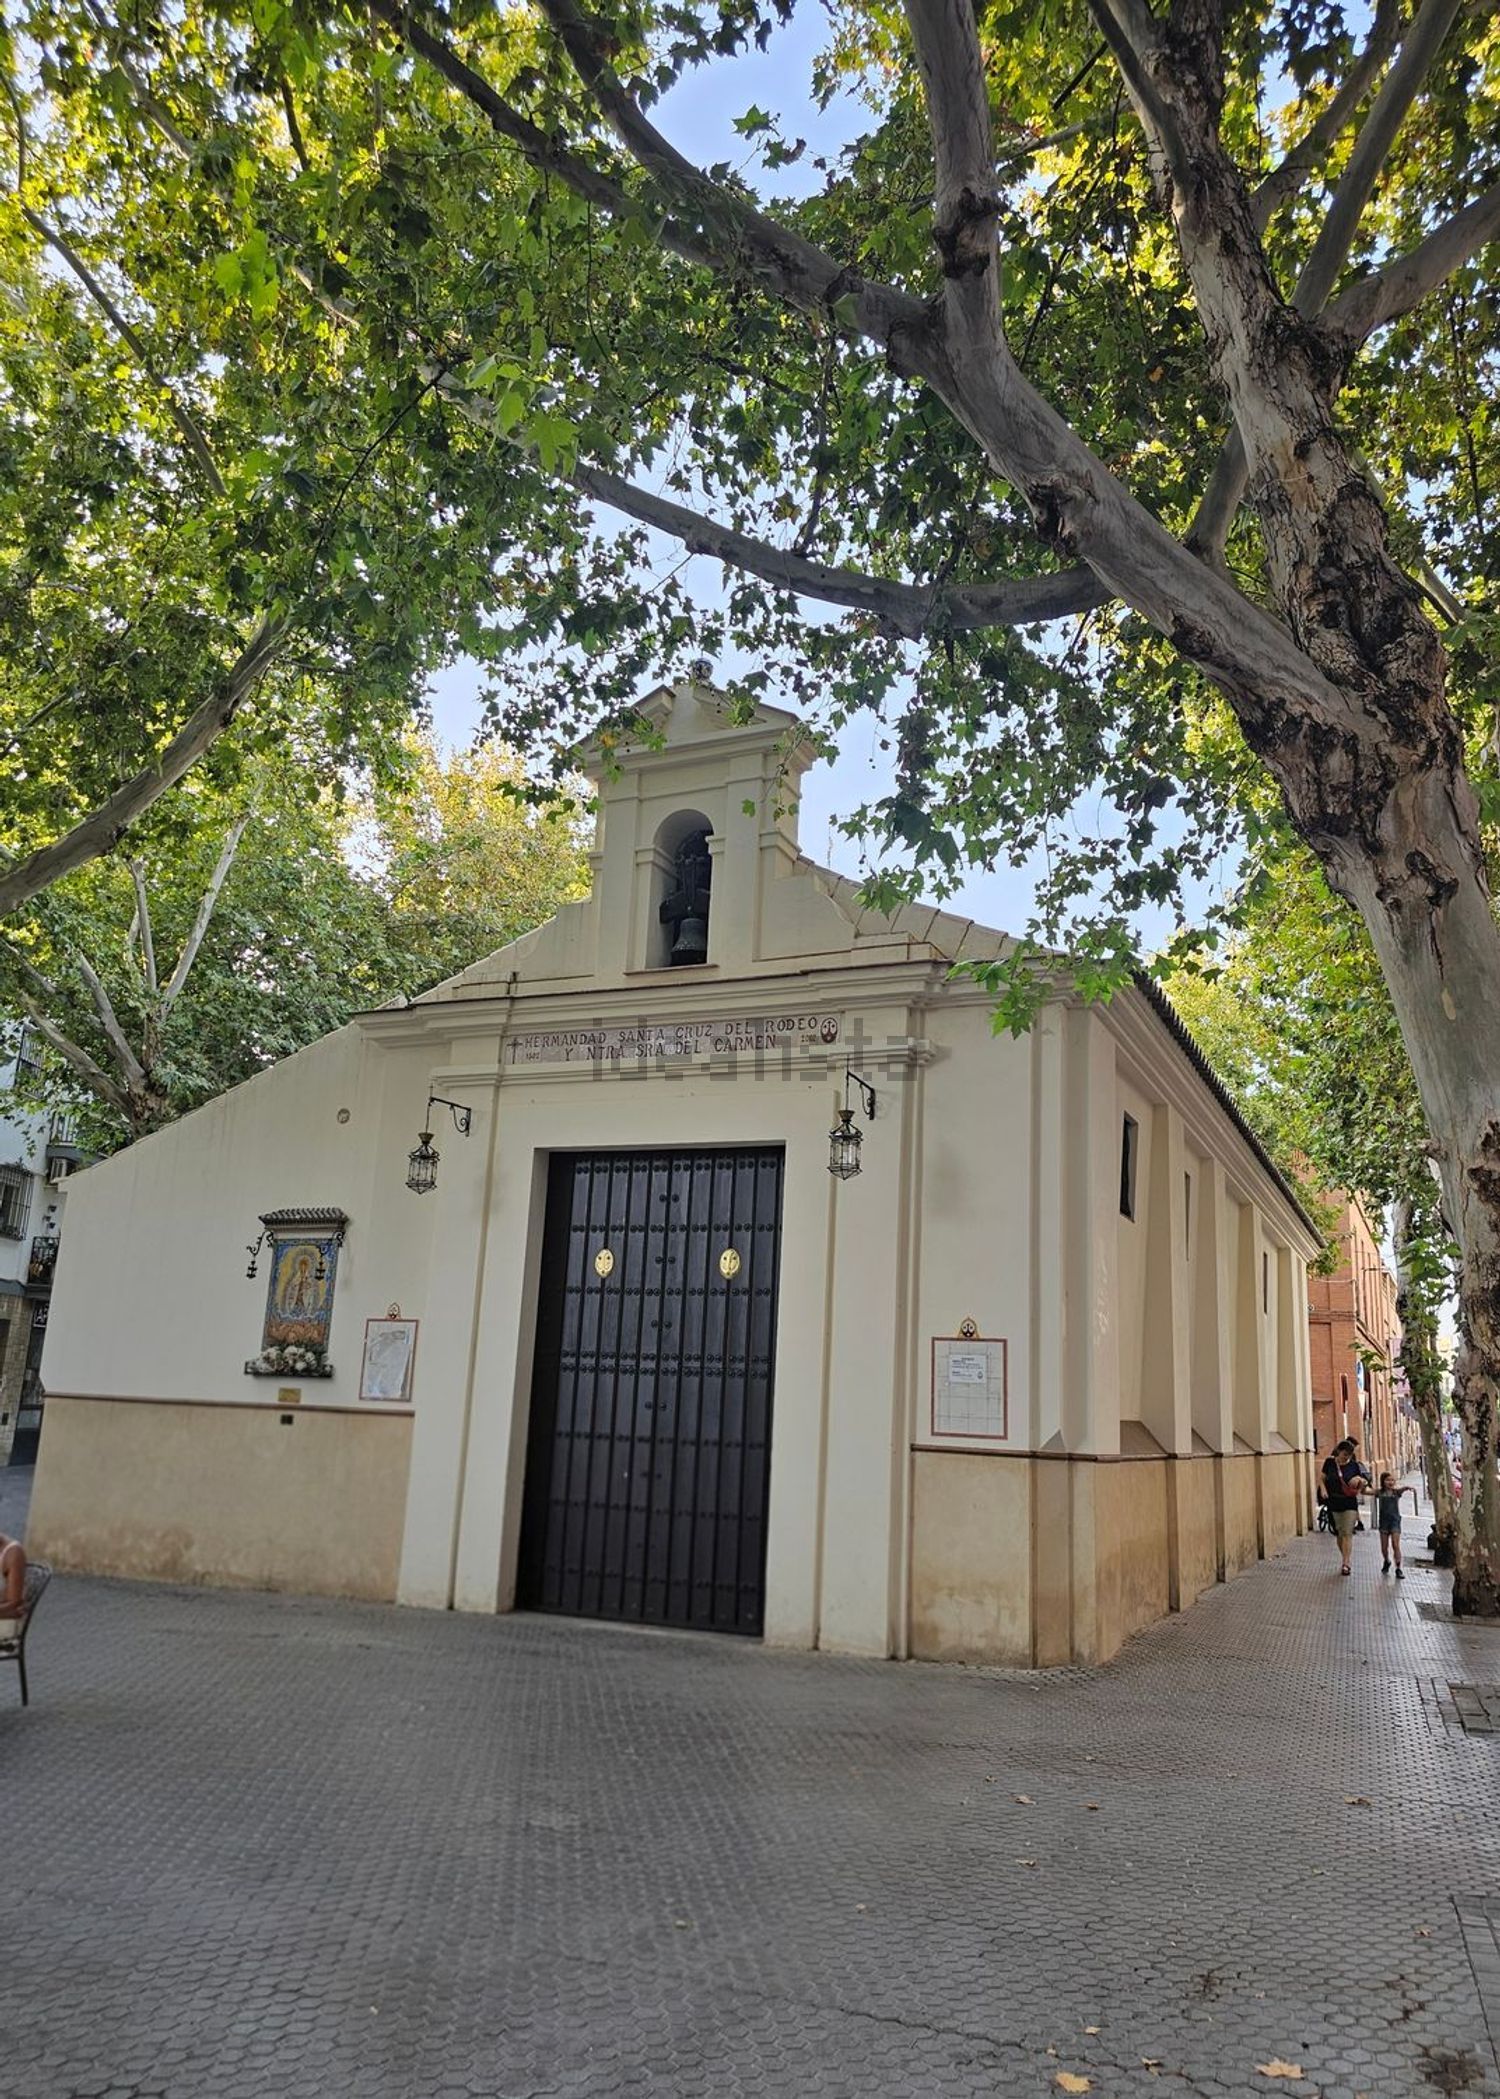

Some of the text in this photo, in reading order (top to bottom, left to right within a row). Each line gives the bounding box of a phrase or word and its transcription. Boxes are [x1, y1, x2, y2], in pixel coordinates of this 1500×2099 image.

[525, 1016, 817, 1048] HERMANDAD SANTA CRUZ DEL RODEO
[565, 1048, 574, 1061] Y
[636, 1042, 665, 1058] SRA
[675, 1039, 702, 1055] DEL
[714, 1035, 776, 1052] CARMEN
